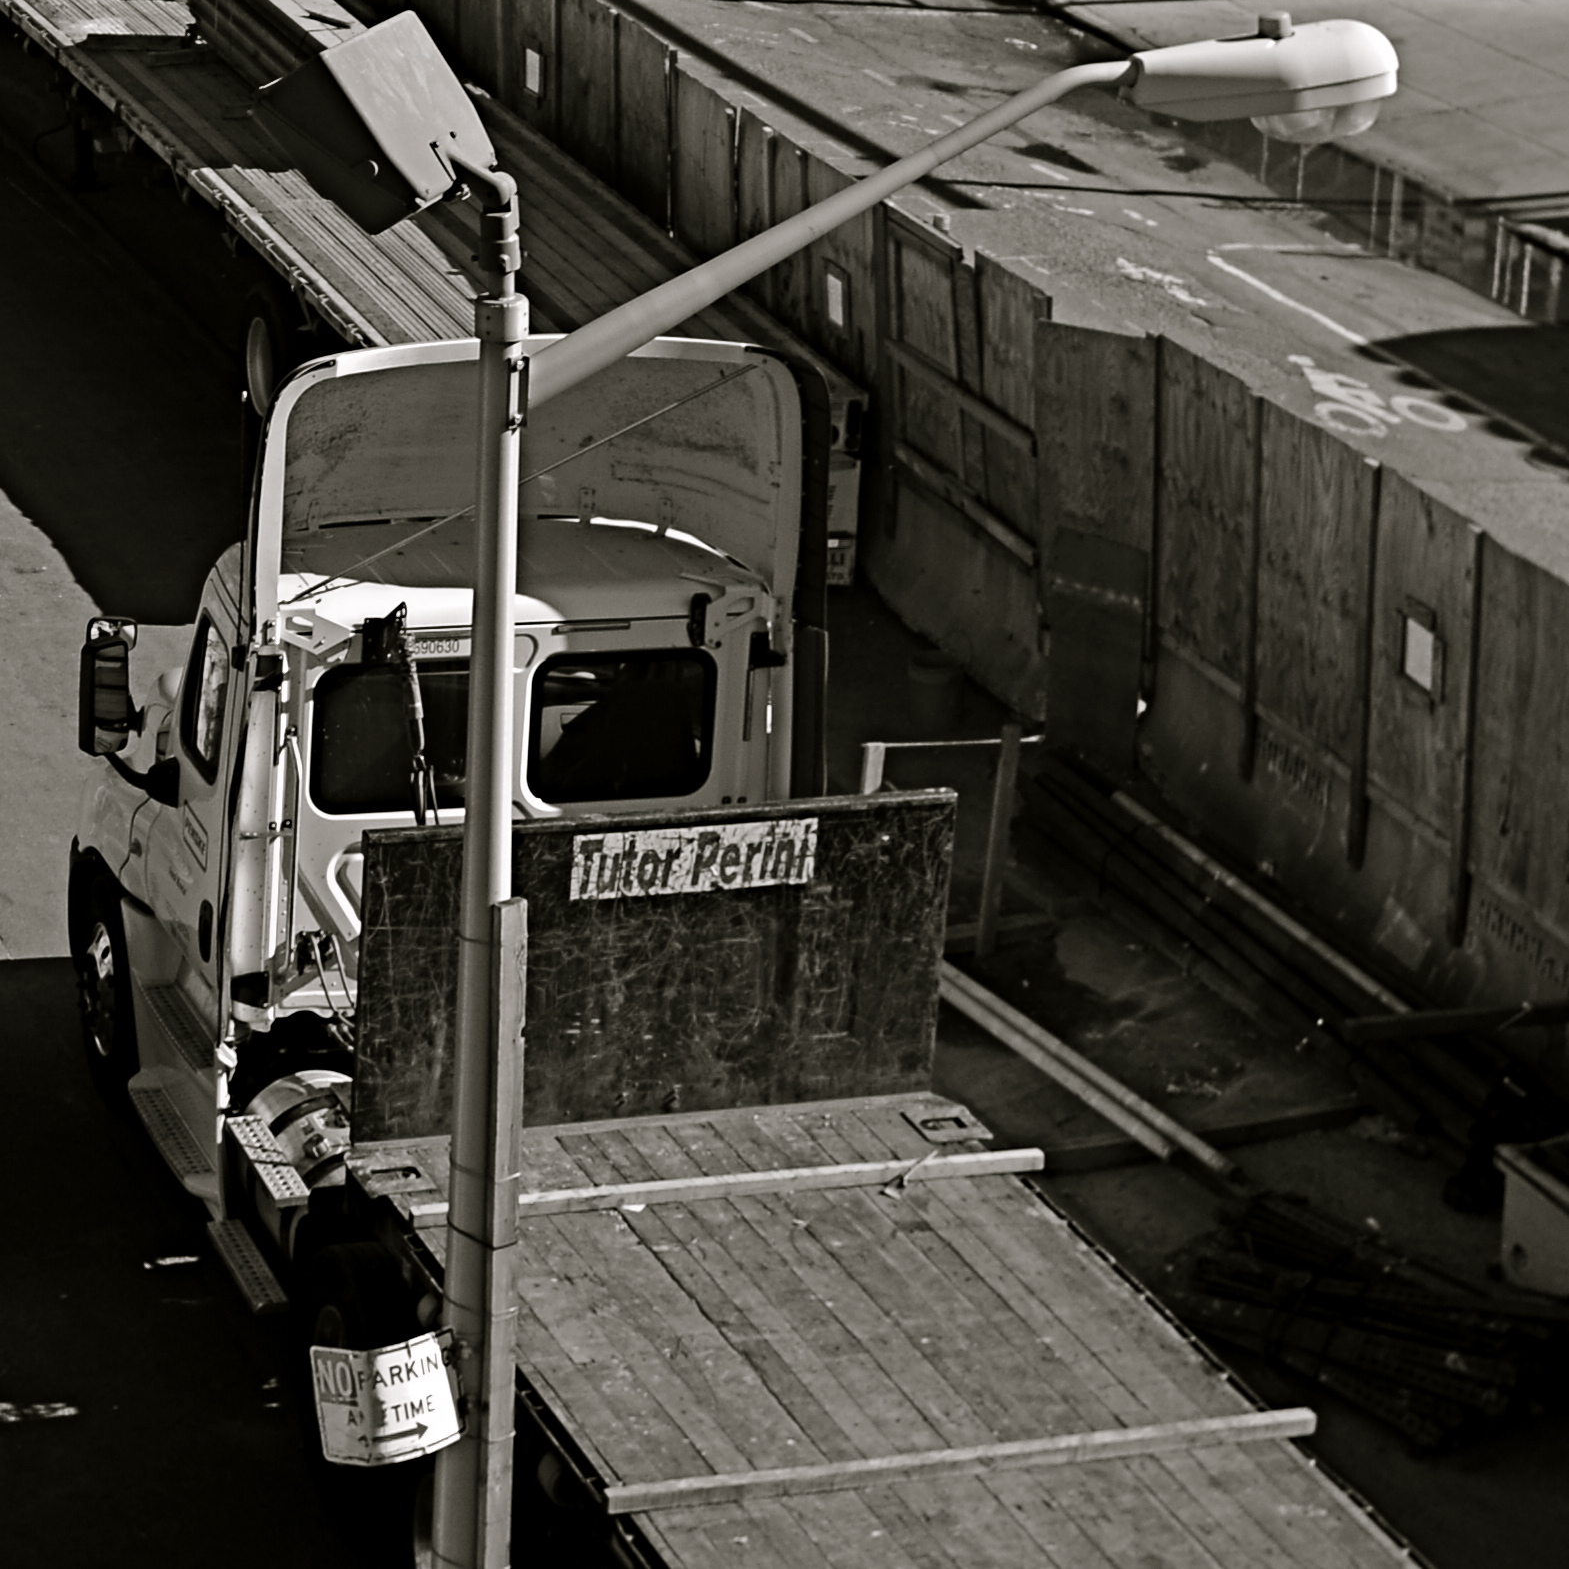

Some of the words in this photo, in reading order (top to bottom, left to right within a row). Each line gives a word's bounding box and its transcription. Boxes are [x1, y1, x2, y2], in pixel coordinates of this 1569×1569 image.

[579, 835, 684, 896] Tutor
[690, 822, 816, 888] Perini
[316, 1357, 353, 1398] NO
